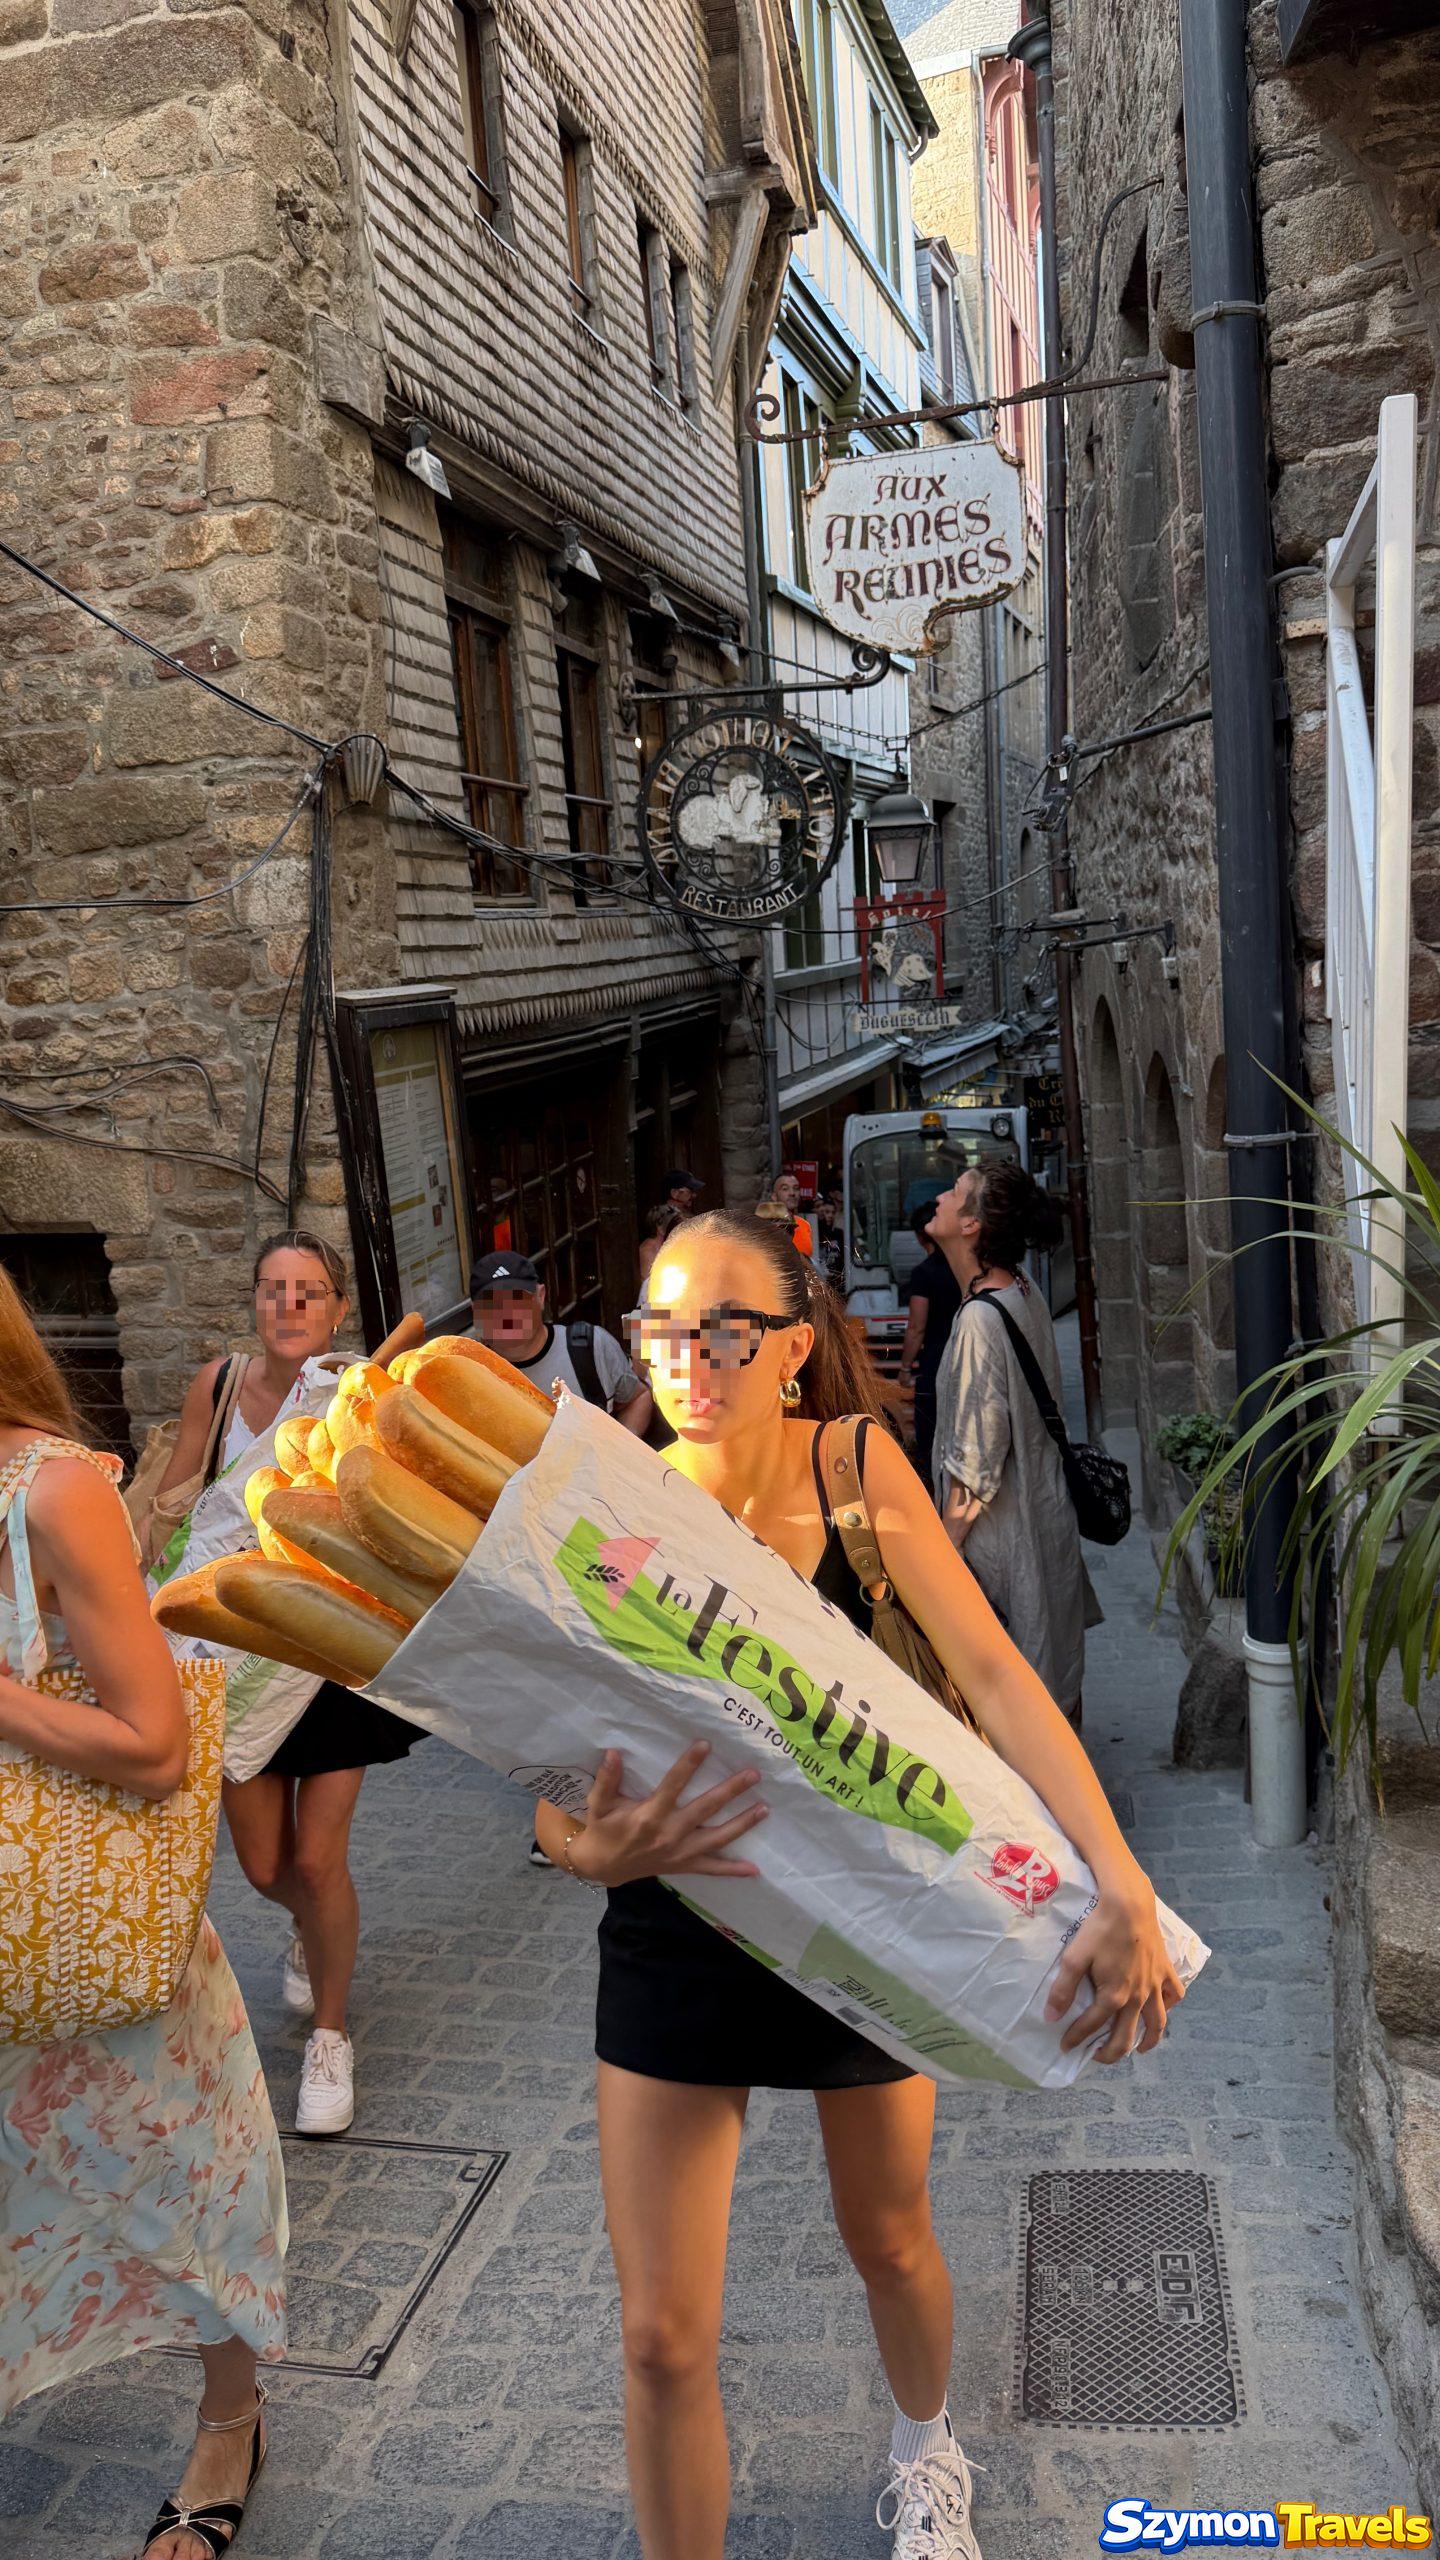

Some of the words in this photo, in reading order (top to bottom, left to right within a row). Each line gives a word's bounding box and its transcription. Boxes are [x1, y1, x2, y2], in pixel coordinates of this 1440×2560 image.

[873, 474, 948, 505] AUX
[822, 493, 991, 566] ARMES
[832, 532, 1012, 621] REUNIES
[681, 882, 800, 916] RESTAURANT
[655, 1569, 692, 1616] La
[686, 1573, 947, 1821] Festive
[723, 1697, 764, 1731] C'EST
[764, 1726, 802, 1760] TOUT
[801, 1755, 825, 1777] UN
[825, 1775, 856, 1800] ART
[855, 1796, 864, 1808] !
[1083, 1894, 1100, 1916] net
